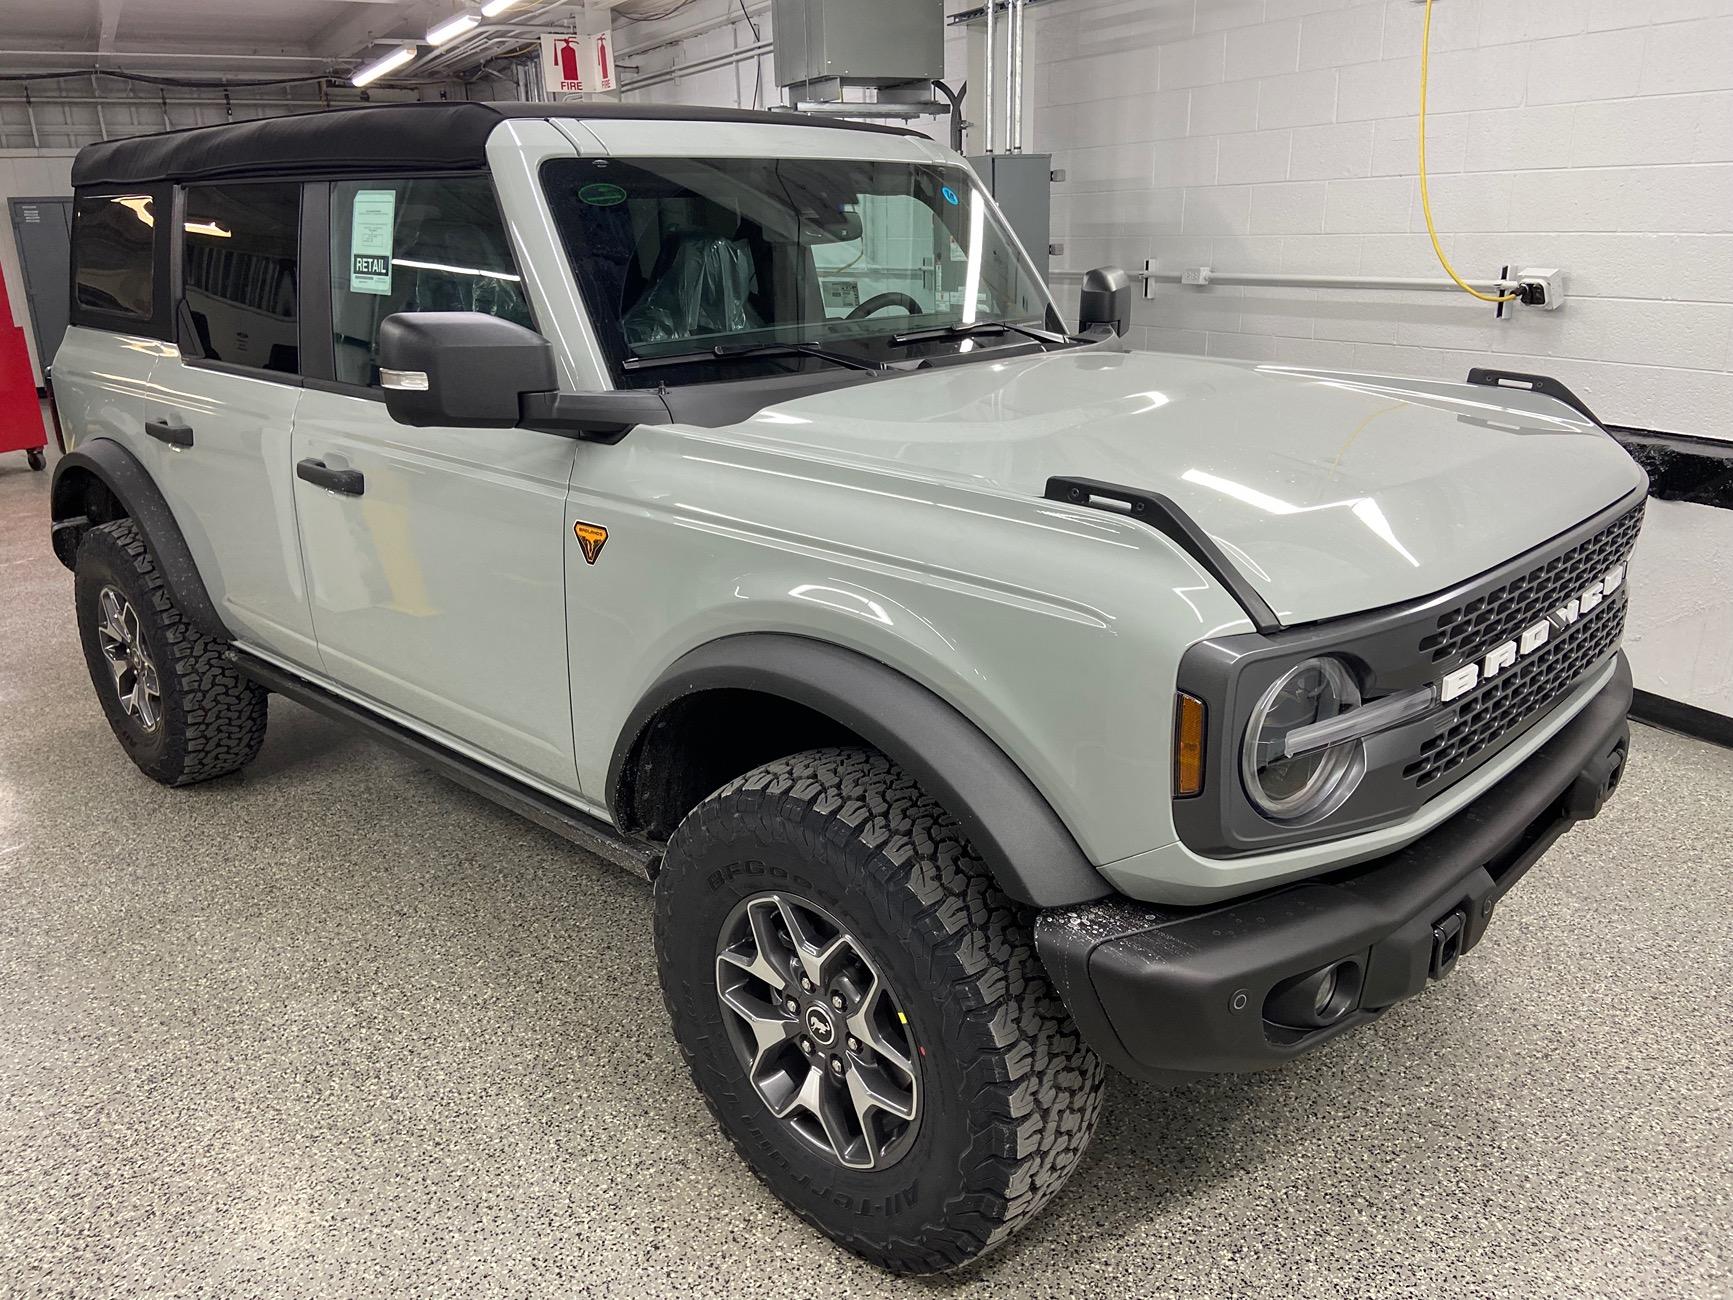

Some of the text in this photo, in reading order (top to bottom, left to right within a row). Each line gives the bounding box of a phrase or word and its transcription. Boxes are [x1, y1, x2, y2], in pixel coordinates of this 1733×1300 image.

[560, 81, 583, 91] FIRE
[356, 257, 386, 274] RETAIL
[1441, 565, 1623, 702] BRONCO
